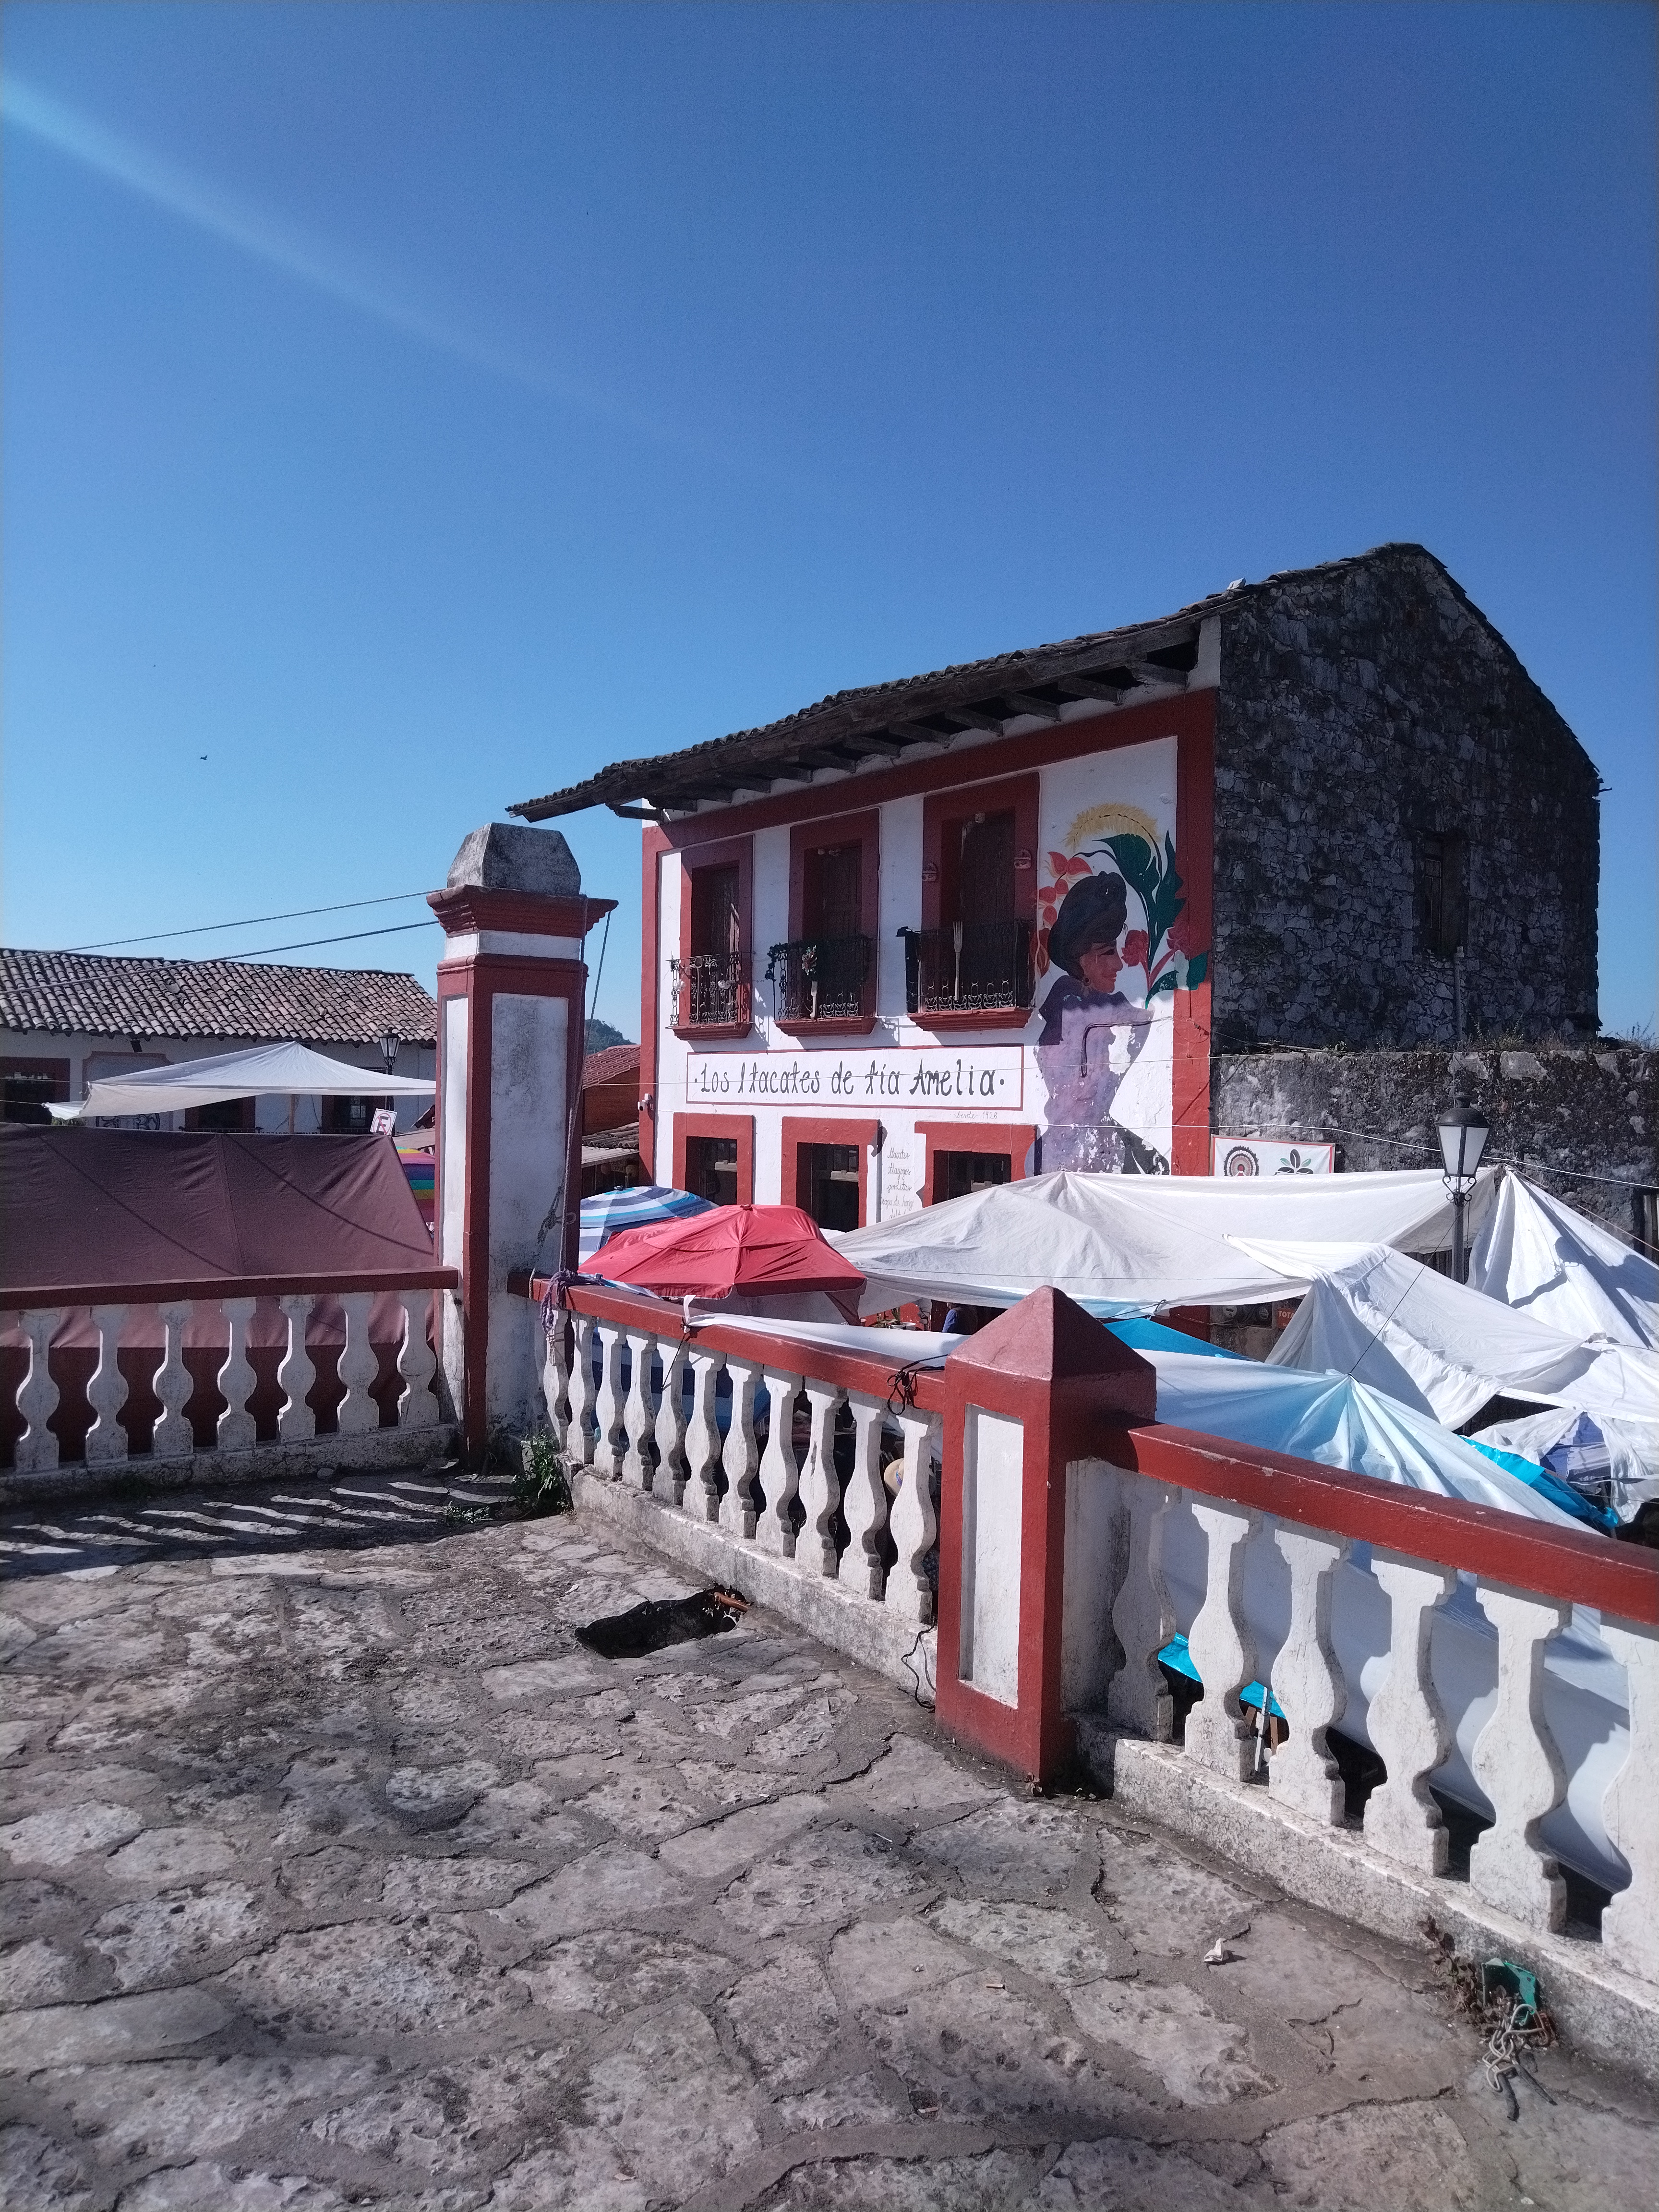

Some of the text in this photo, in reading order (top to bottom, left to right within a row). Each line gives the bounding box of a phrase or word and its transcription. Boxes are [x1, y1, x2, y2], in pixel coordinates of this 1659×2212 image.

[701, 1058, 996, 1096] Los Itacates de tía Amelia
[954, 1111, 998, 1119] Desde 1926
